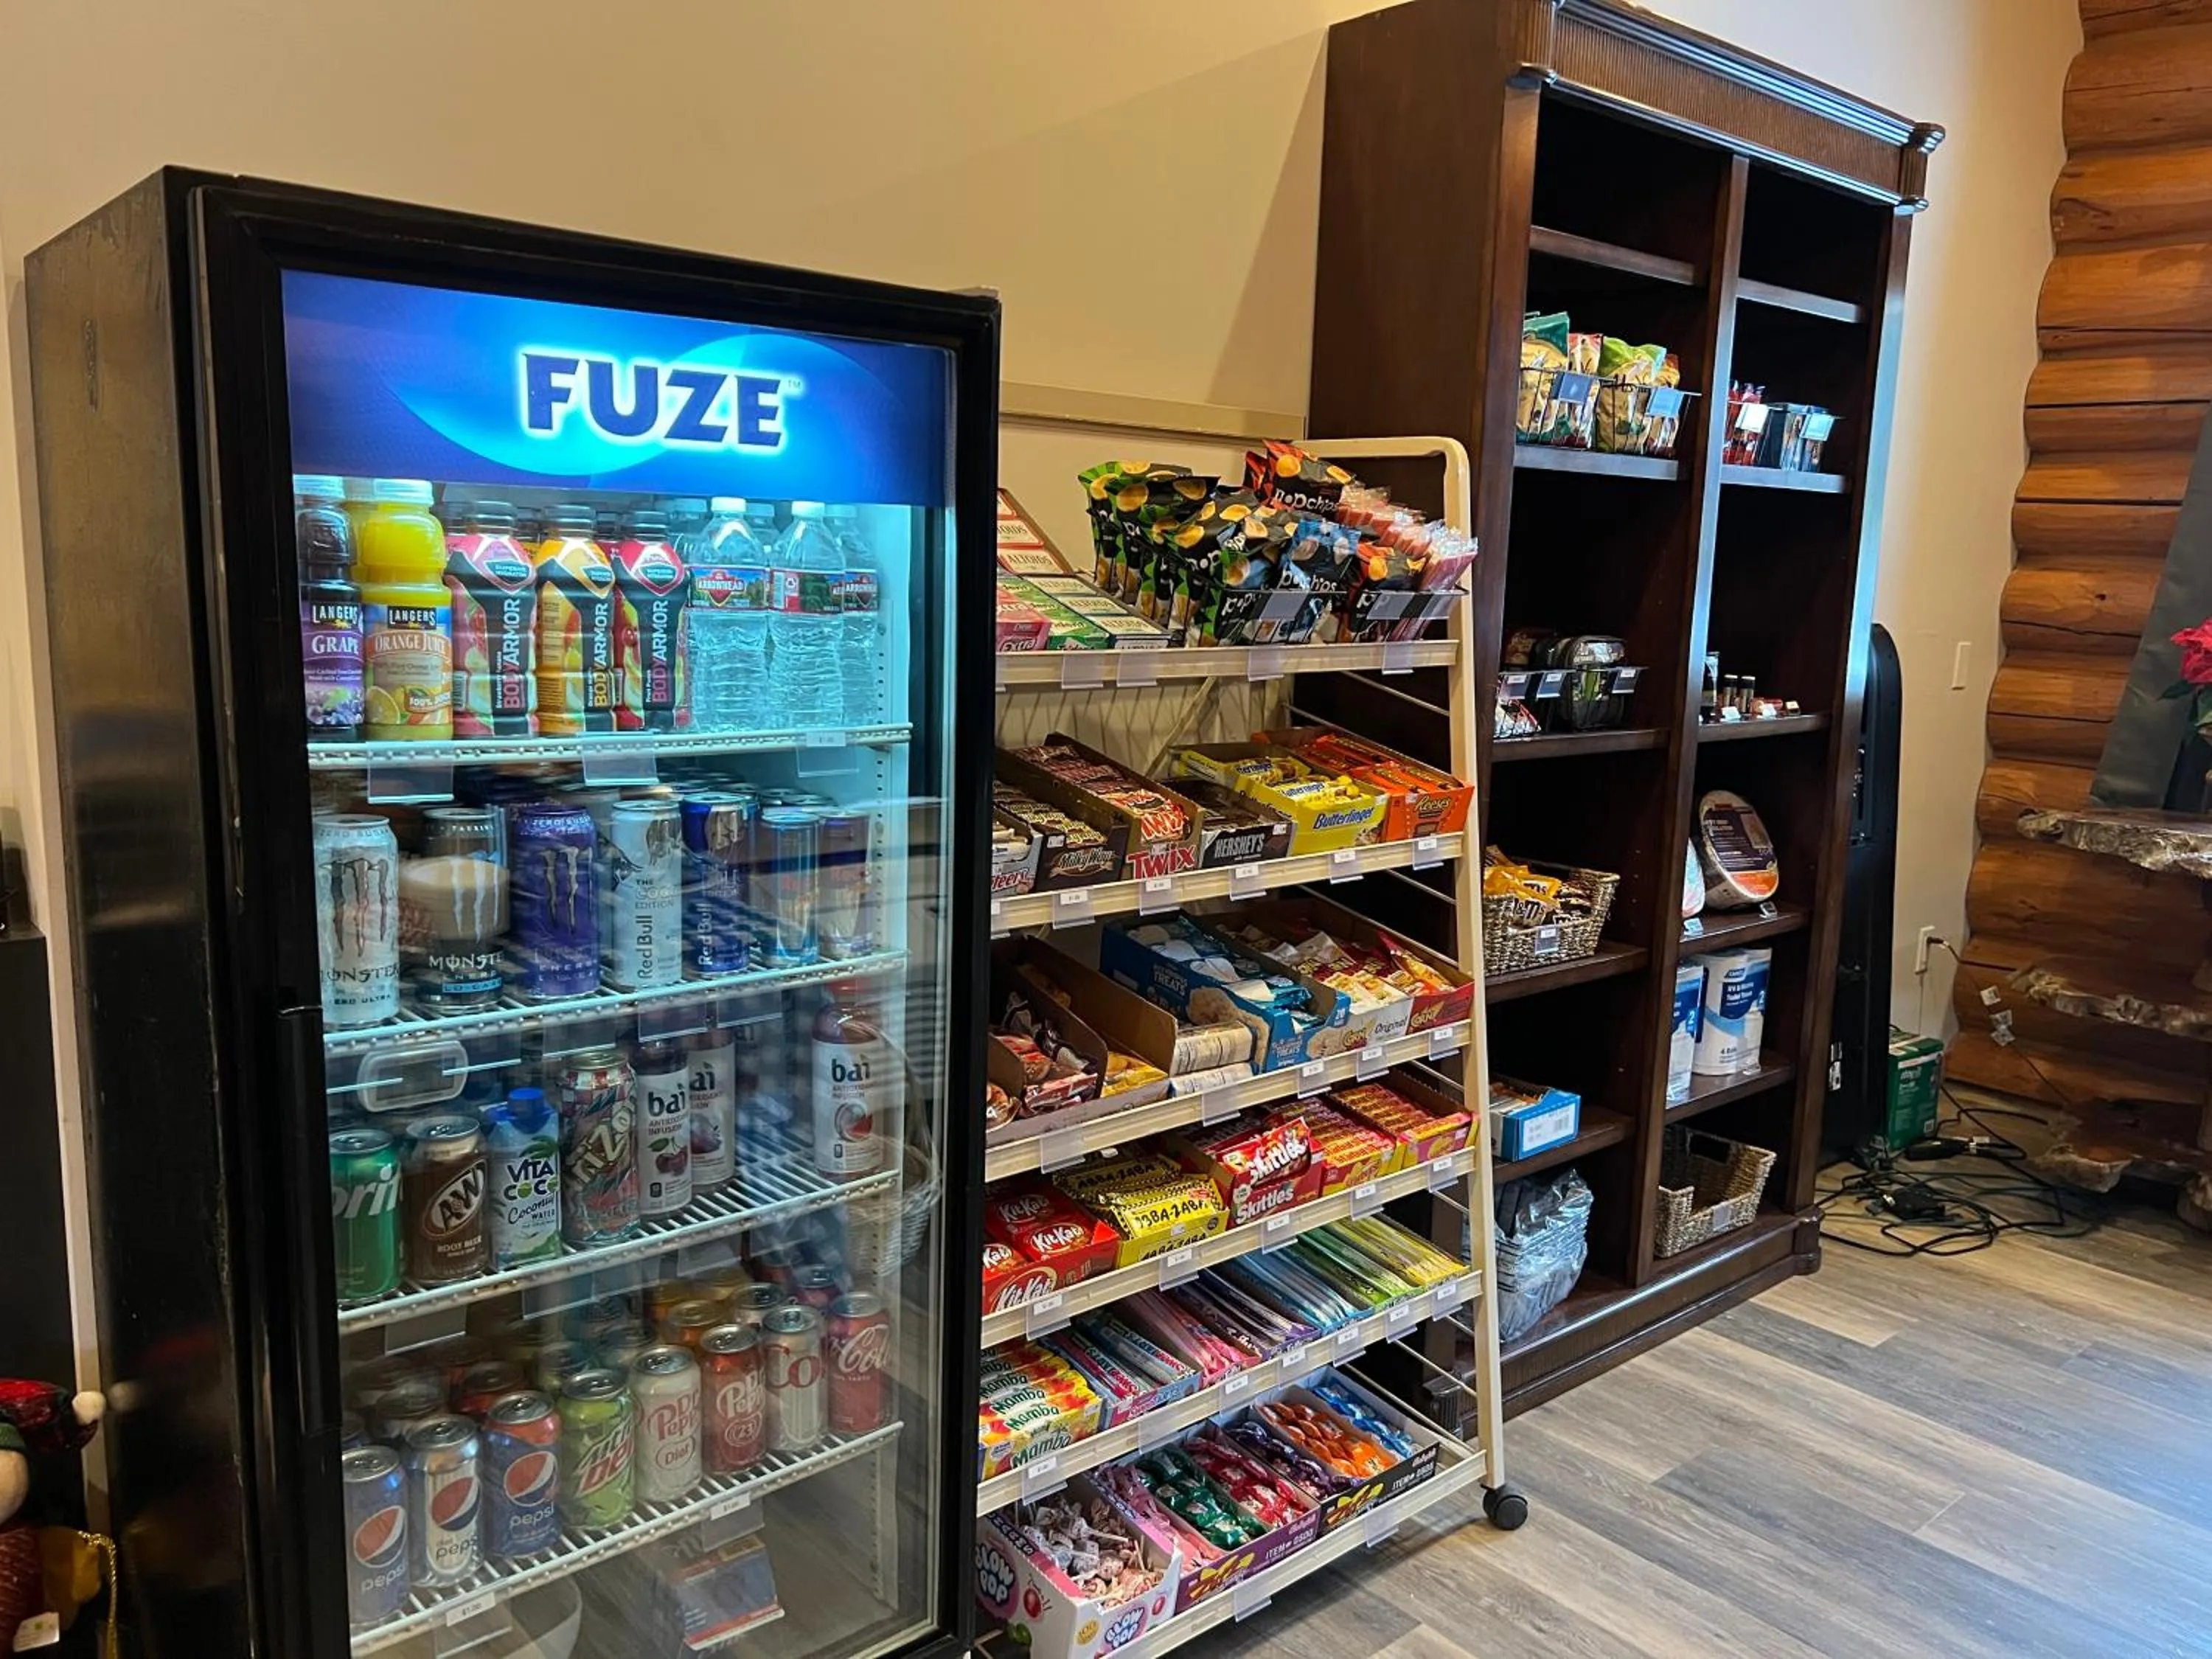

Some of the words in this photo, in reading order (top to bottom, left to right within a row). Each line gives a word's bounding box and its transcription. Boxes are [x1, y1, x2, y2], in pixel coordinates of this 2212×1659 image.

[521, 352, 785, 448] FUZE
[1274, 489, 1338, 512] popchips
[698, 580, 744, 590] ARROWHEAD
[312, 605, 358, 625] LANGERS
[389, 608, 436, 626] LANGERS
[311, 634, 359, 655] GRAPE
[375, 633, 420, 652] ORANGE
[503, 597, 521, 709] BODYARMOR
[593, 602, 608, 709] BODYARMOR
[652, 599, 669, 703] BODYARMOR
[1312, 808, 1374, 830] Butterfinger
[1214, 833, 1266, 858] HERSHEY'S
[1127, 845, 1197, 880] TWIX
[635, 914, 653, 945] Bull
[428, 950, 505, 972] MONSTE
[635, 945, 653, 979] Red
[1688, 1010, 1696, 1025] 2
[689, 1062, 716, 1091] ai
[831, 1053, 871, 1082] bai
[647, 1082, 686, 1117] bai
[507, 1158, 554, 1182] VITA
[1247, 1138, 1309, 1186] Skittles
[438, 1166, 485, 1233] A&W
[1236, 1188, 1295, 1225] Skittles
[990, 1386, 1046, 1415] Mamba
[1005, 1404, 1060, 1431] Mamba
[1011, 1428, 1074, 1470] Mamba
[509, 1503, 554, 1528] pepsi
[435, 1537, 479, 1561] peps
[360, 1564, 406, 1592] pepsi
[979, 1569, 1009, 1604] POP
[1105, 1607, 1144, 1642] BLOW
